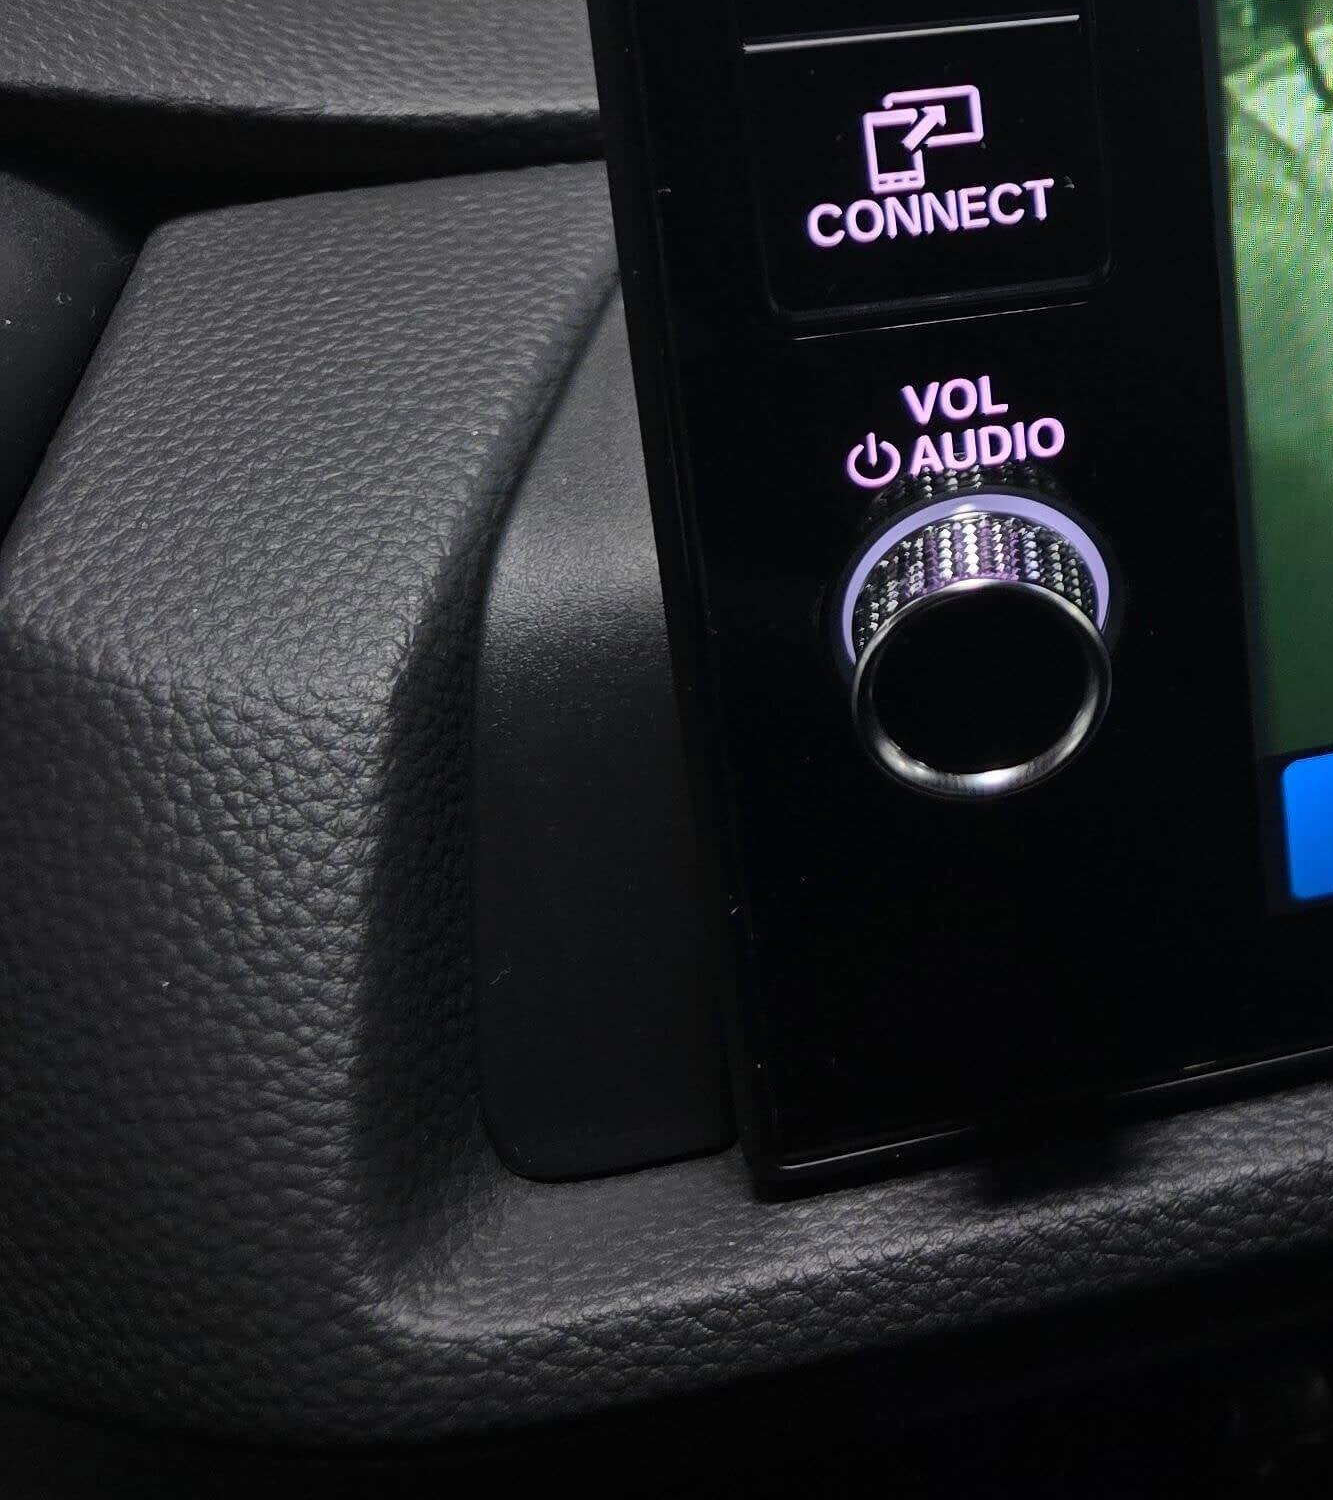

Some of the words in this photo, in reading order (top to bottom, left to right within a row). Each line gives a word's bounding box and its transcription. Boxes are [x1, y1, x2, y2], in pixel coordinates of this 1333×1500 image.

[805, 177, 1056, 248] CONNECT
[900, 375, 1009, 425] VOL
[908, 417, 1066, 477] AUDIO
